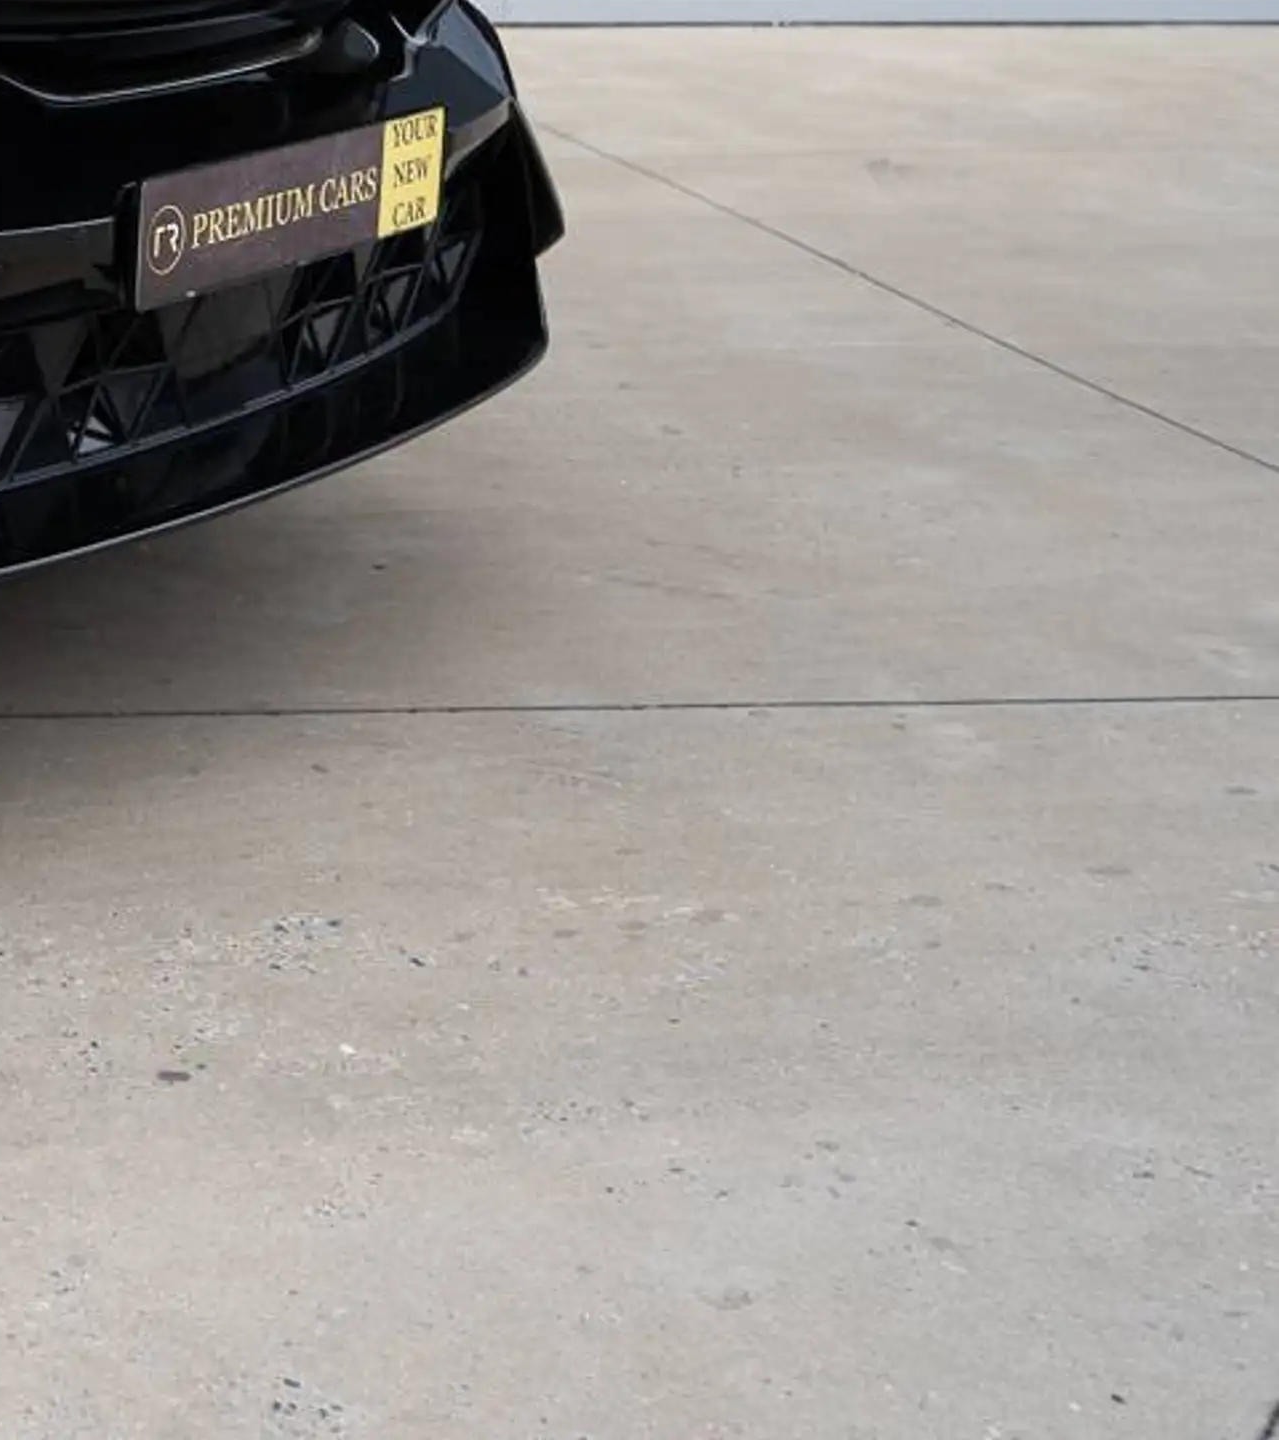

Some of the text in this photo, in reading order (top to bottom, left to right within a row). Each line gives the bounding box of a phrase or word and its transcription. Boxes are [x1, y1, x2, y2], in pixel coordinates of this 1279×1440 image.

[391, 113, 438, 148] YOUR
[392, 156, 432, 188] NEW
[190, 183, 316, 250] PREMIUM
[317, 166, 380, 213] CARS
[391, 197, 427, 229] CAR
